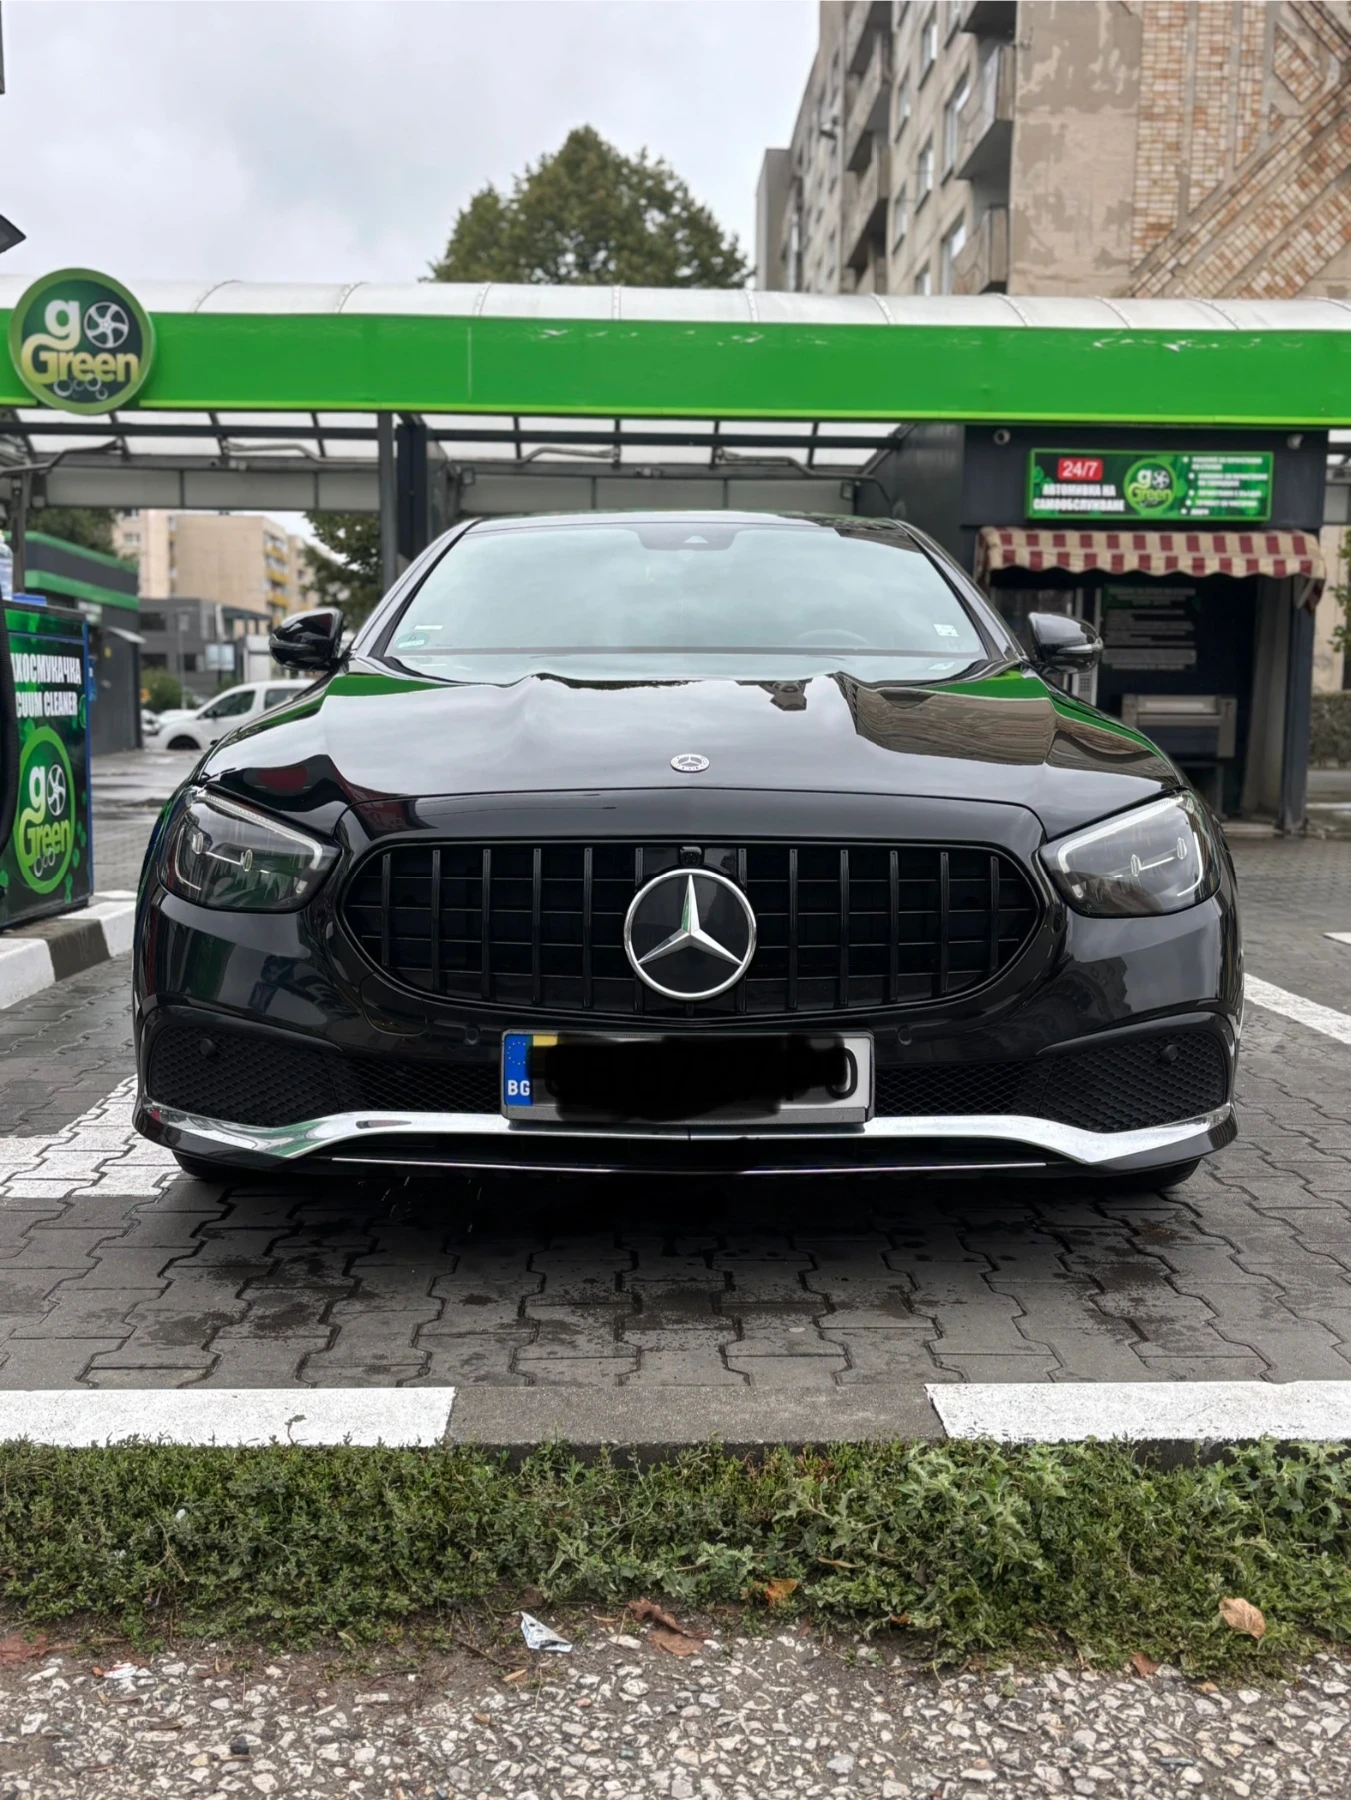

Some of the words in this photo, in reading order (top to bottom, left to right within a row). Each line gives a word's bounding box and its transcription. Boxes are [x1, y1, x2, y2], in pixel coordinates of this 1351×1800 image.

[21, 334, 140, 385] Green
[1062, 461, 1099, 478] 24/7
[1128, 483, 1173, 502] Green
[44, 691, 78, 717] CLEANER
[19, 808, 71, 867] Green
[507, 1079, 531, 1097] BG
